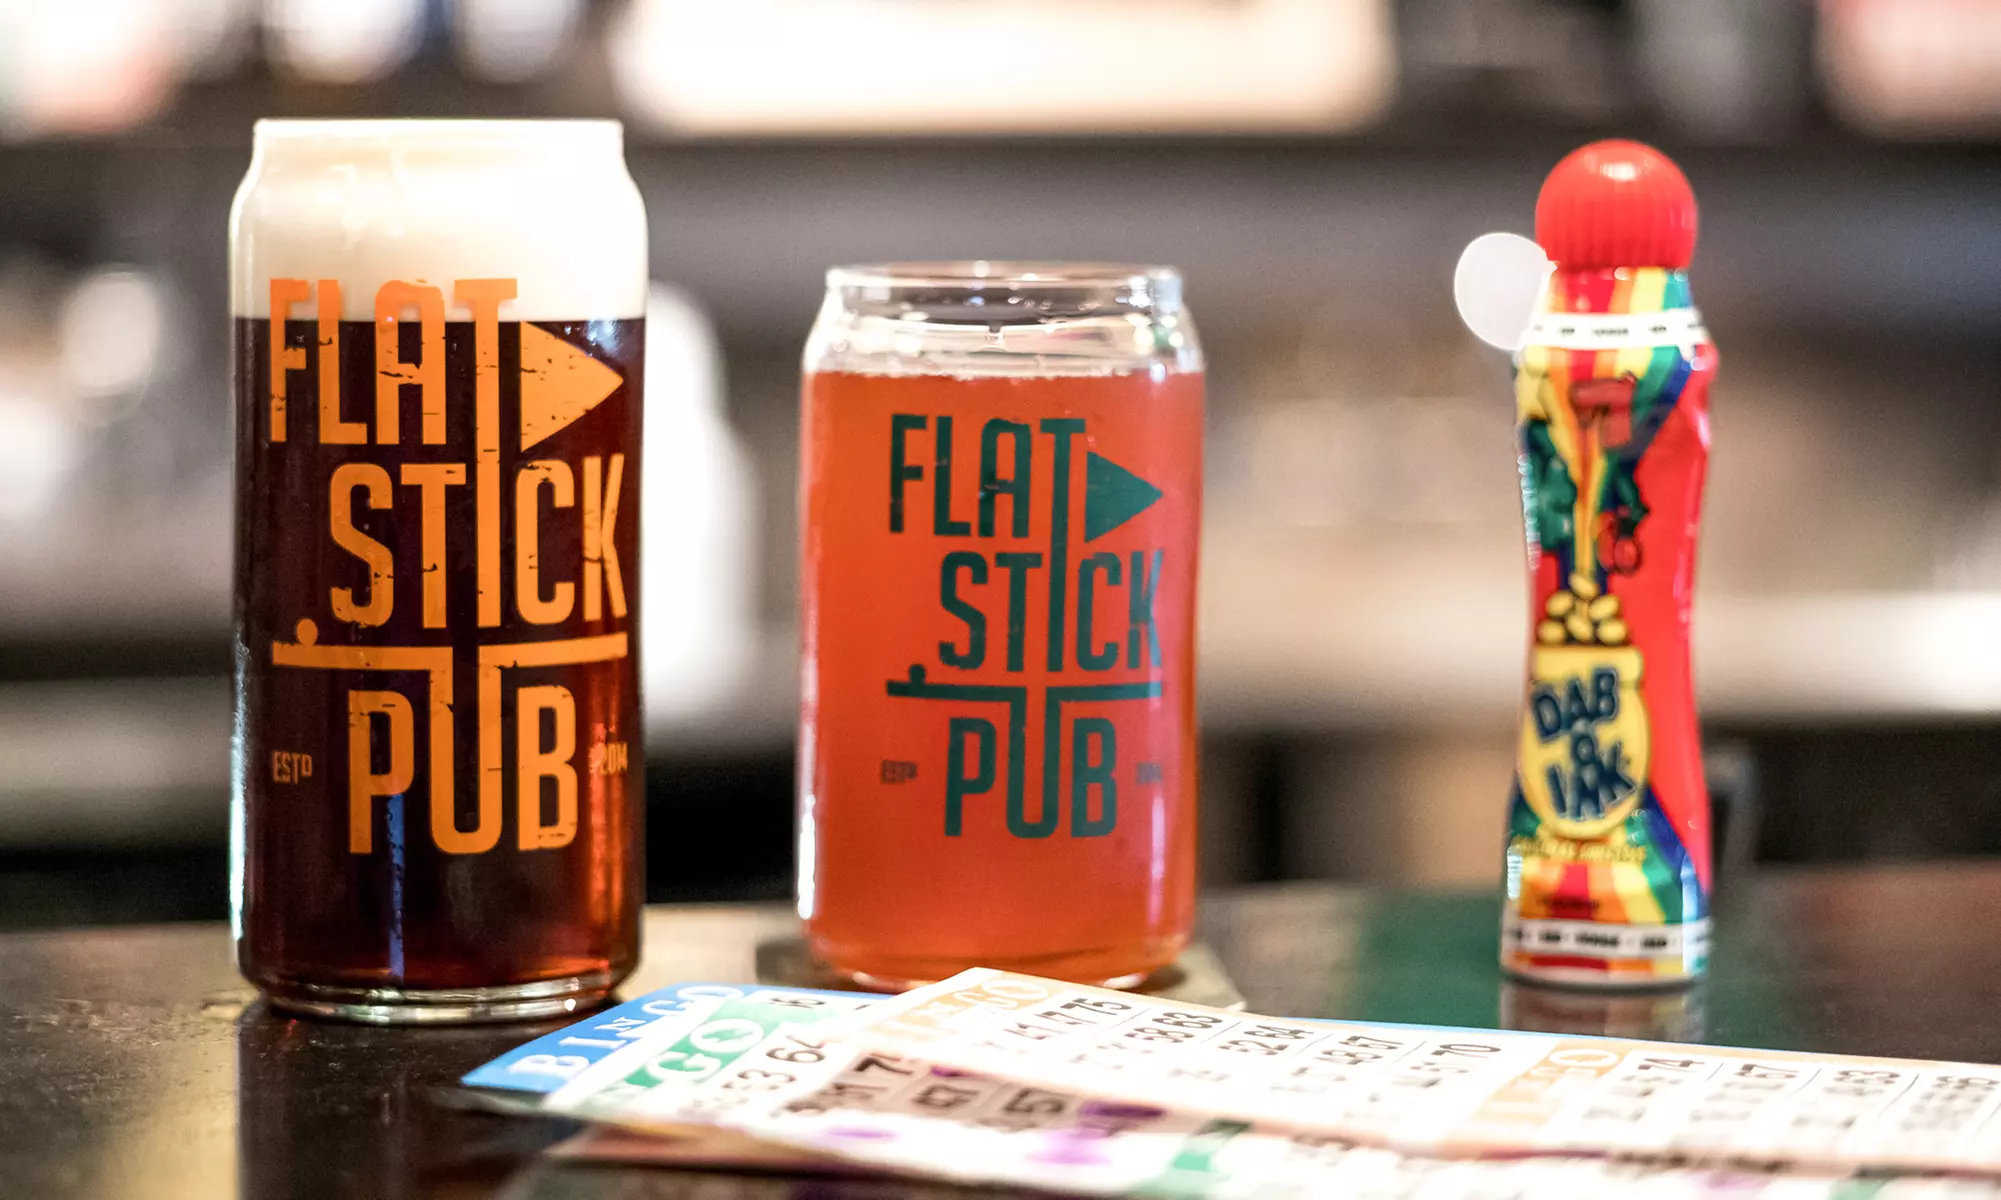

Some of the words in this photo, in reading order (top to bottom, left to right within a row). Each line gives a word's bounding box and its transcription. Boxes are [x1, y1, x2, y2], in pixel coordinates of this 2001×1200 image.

[269, 278, 518, 446] FLAT
[889, 413, 1086, 539] FLAT
[330, 453, 628, 628] STICK
[937, 549, 1165, 673] STICK
[1531, 670, 1620, 745] DAB
[348, 684, 579, 855] PUB
[944, 717, 1117, 839] PUB
[505, 985, 745, 1076] BINGO
[1060, 997, 1133, 1016] 75
[1151, 1011, 1224, 1029] 63
